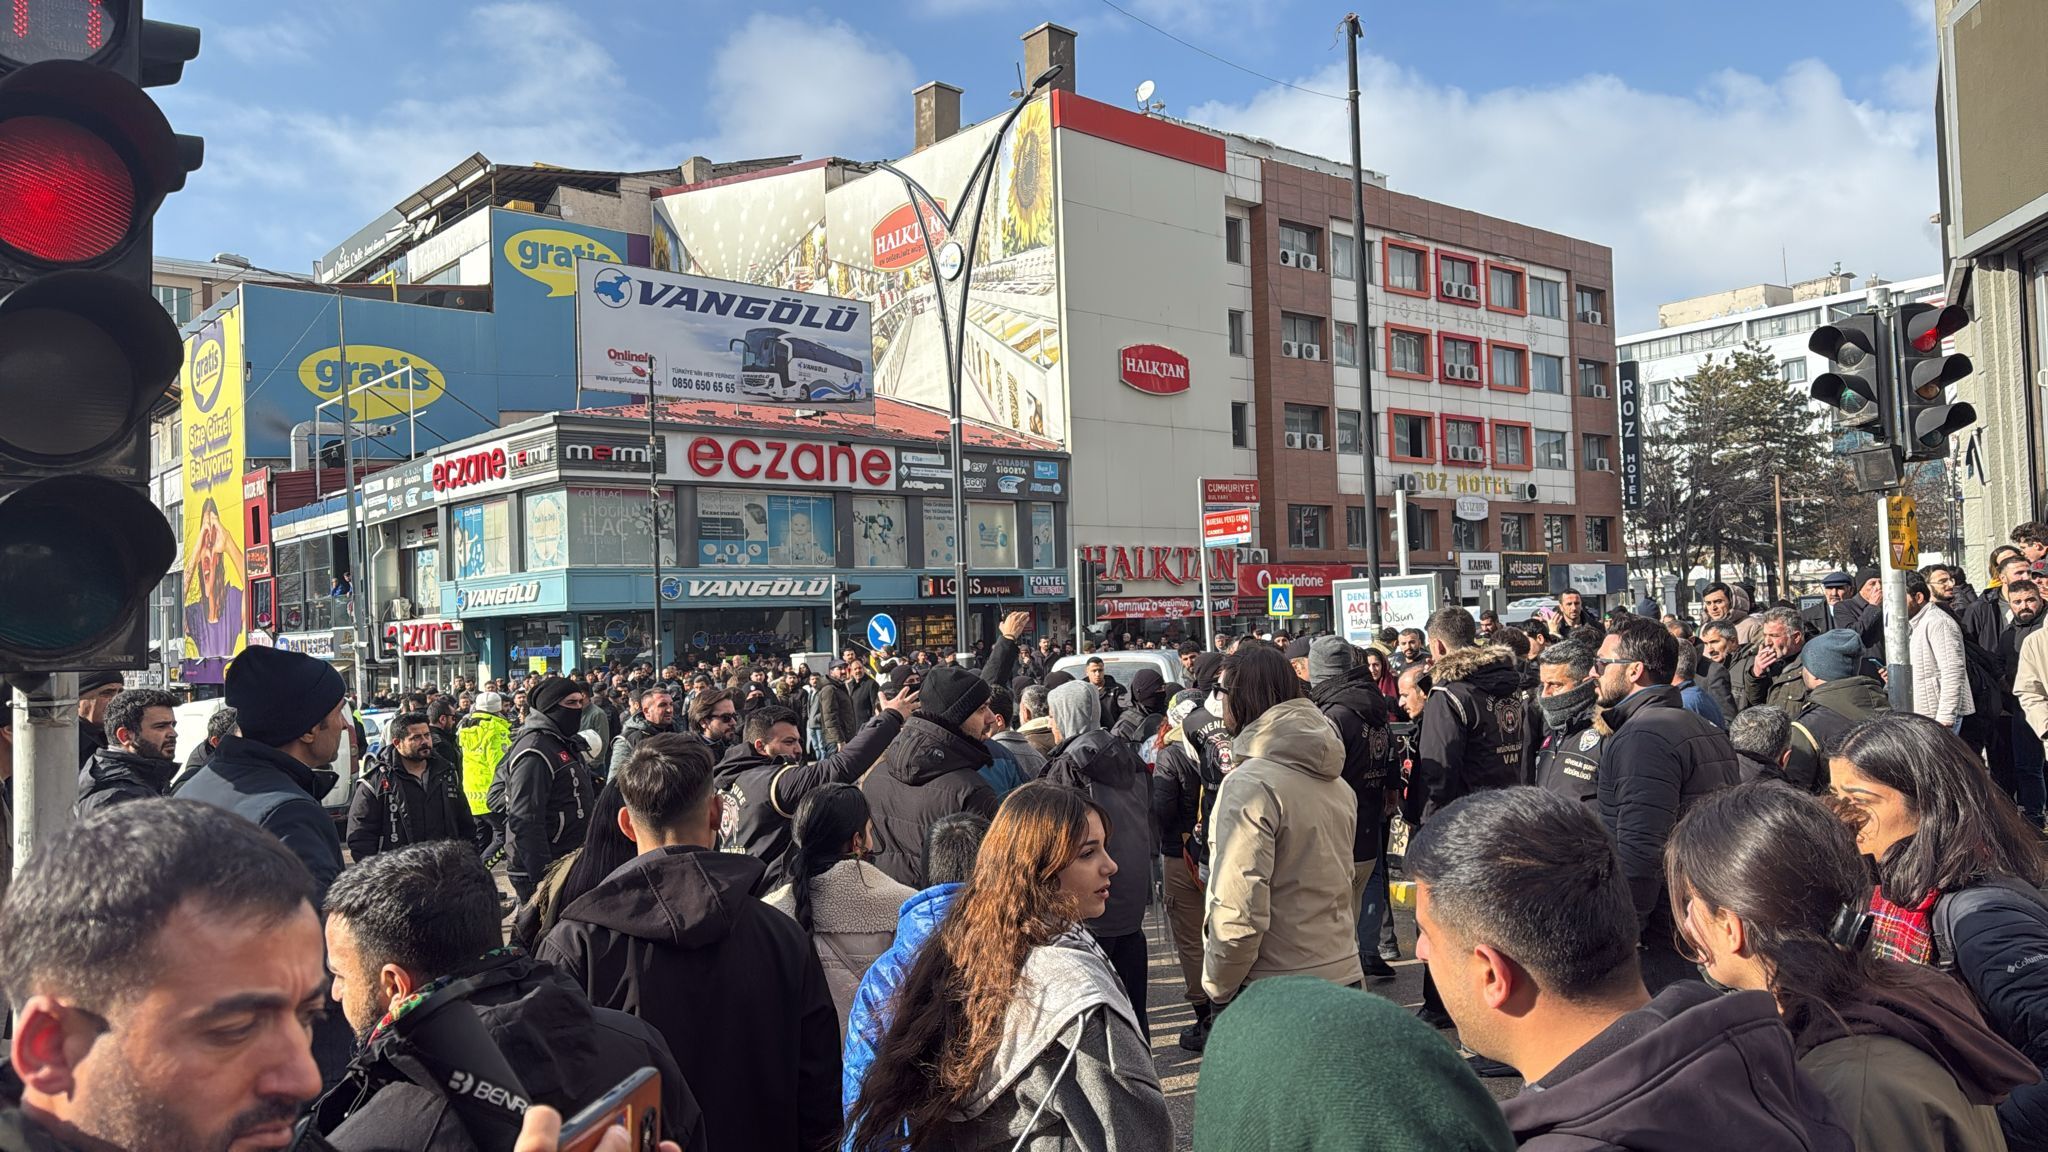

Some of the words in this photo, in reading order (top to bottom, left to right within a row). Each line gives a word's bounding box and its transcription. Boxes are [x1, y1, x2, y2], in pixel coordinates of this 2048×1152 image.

[876, 216, 942, 256] HALKTN
[636, 279, 860, 333] VANGÖLÜ
[196, 344, 219, 387] gratis
[608, 348, 649, 363] Online!
[1125, 356, 1185, 379] HALKTAN
[315, 357, 430, 393] gratis
[672, 377, 693, 390] 0850
[694, 378, 711, 392] 650
[712, 381, 724, 393] 65
[724, 382, 736, 395] 65
[1621, 379, 1636, 438] ROZ
[189, 423, 206, 451] Size
[206, 407, 232, 445] Güzel
[190, 449, 233, 486] Bakıyoruz
[432, 447, 507, 493] eczane
[687, 436, 892, 487] eczane
[996, 466, 1027, 475] SİGORTA
[1626, 454, 1638, 505] HOTEL
[1207, 483, 1254, 493] CUMHURİYET
[1457, 474, 1512, 495] HOTEL
[1029, 576, 1066, 585] FONTEL
[1082, 545, 1237, 587] HALKTAN
[1275, 575, 1324, 587] vodafone
[468, 581, 542, 606] VANGÖLÜ
[688, 576, 829, 598] VANGÖLÜ
[940, 578, 981, 594] LOIS
[1214, 598, 1230, 610] YOK
[1384, 612, 1414, 624] Olsun
[570, 767, 585, 819] POLİS
[388, 794, 399, 843] POLİS
[473, 1080, 533, 1116] BENR
